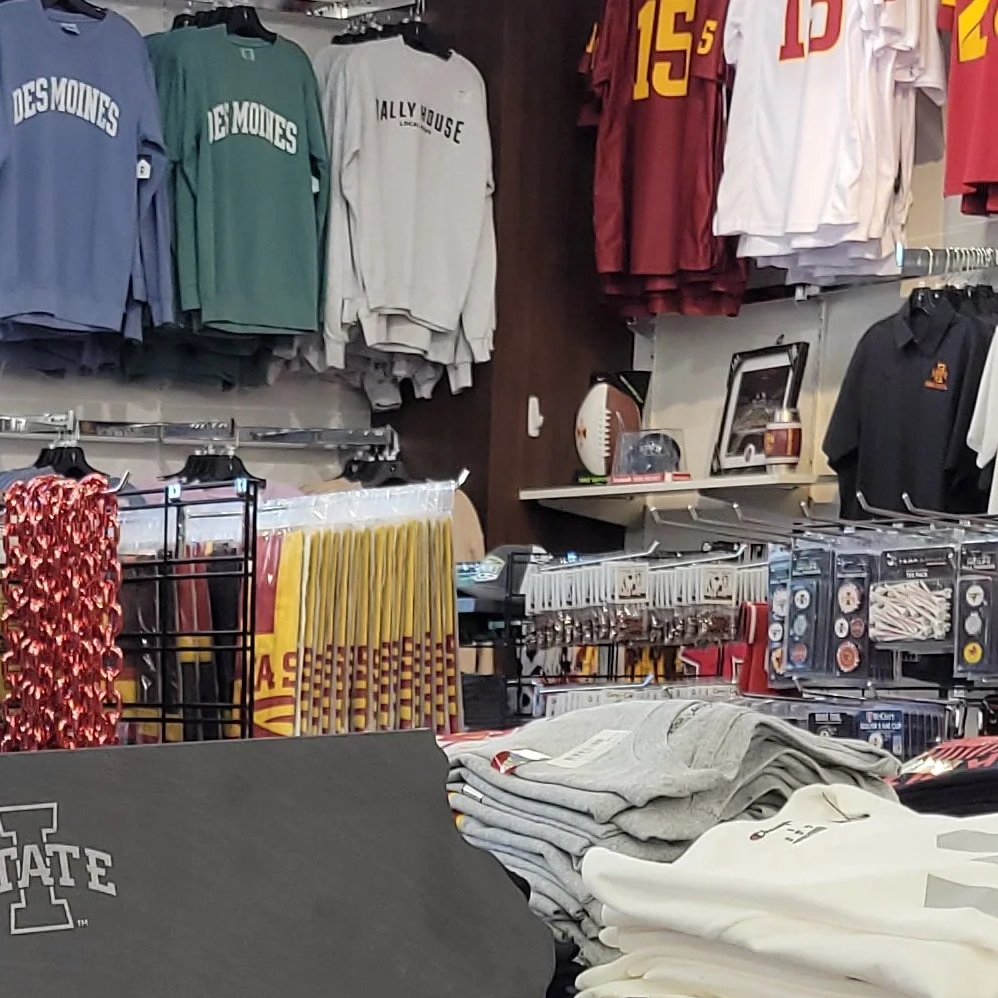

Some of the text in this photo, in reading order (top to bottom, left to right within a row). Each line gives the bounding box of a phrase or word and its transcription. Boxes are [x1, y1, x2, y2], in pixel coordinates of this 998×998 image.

[634, 0, 697, 99] 15
[12, 76, 120, 137] DES MOINES
[375, 97, 465, 144] ALLY HOUSE
